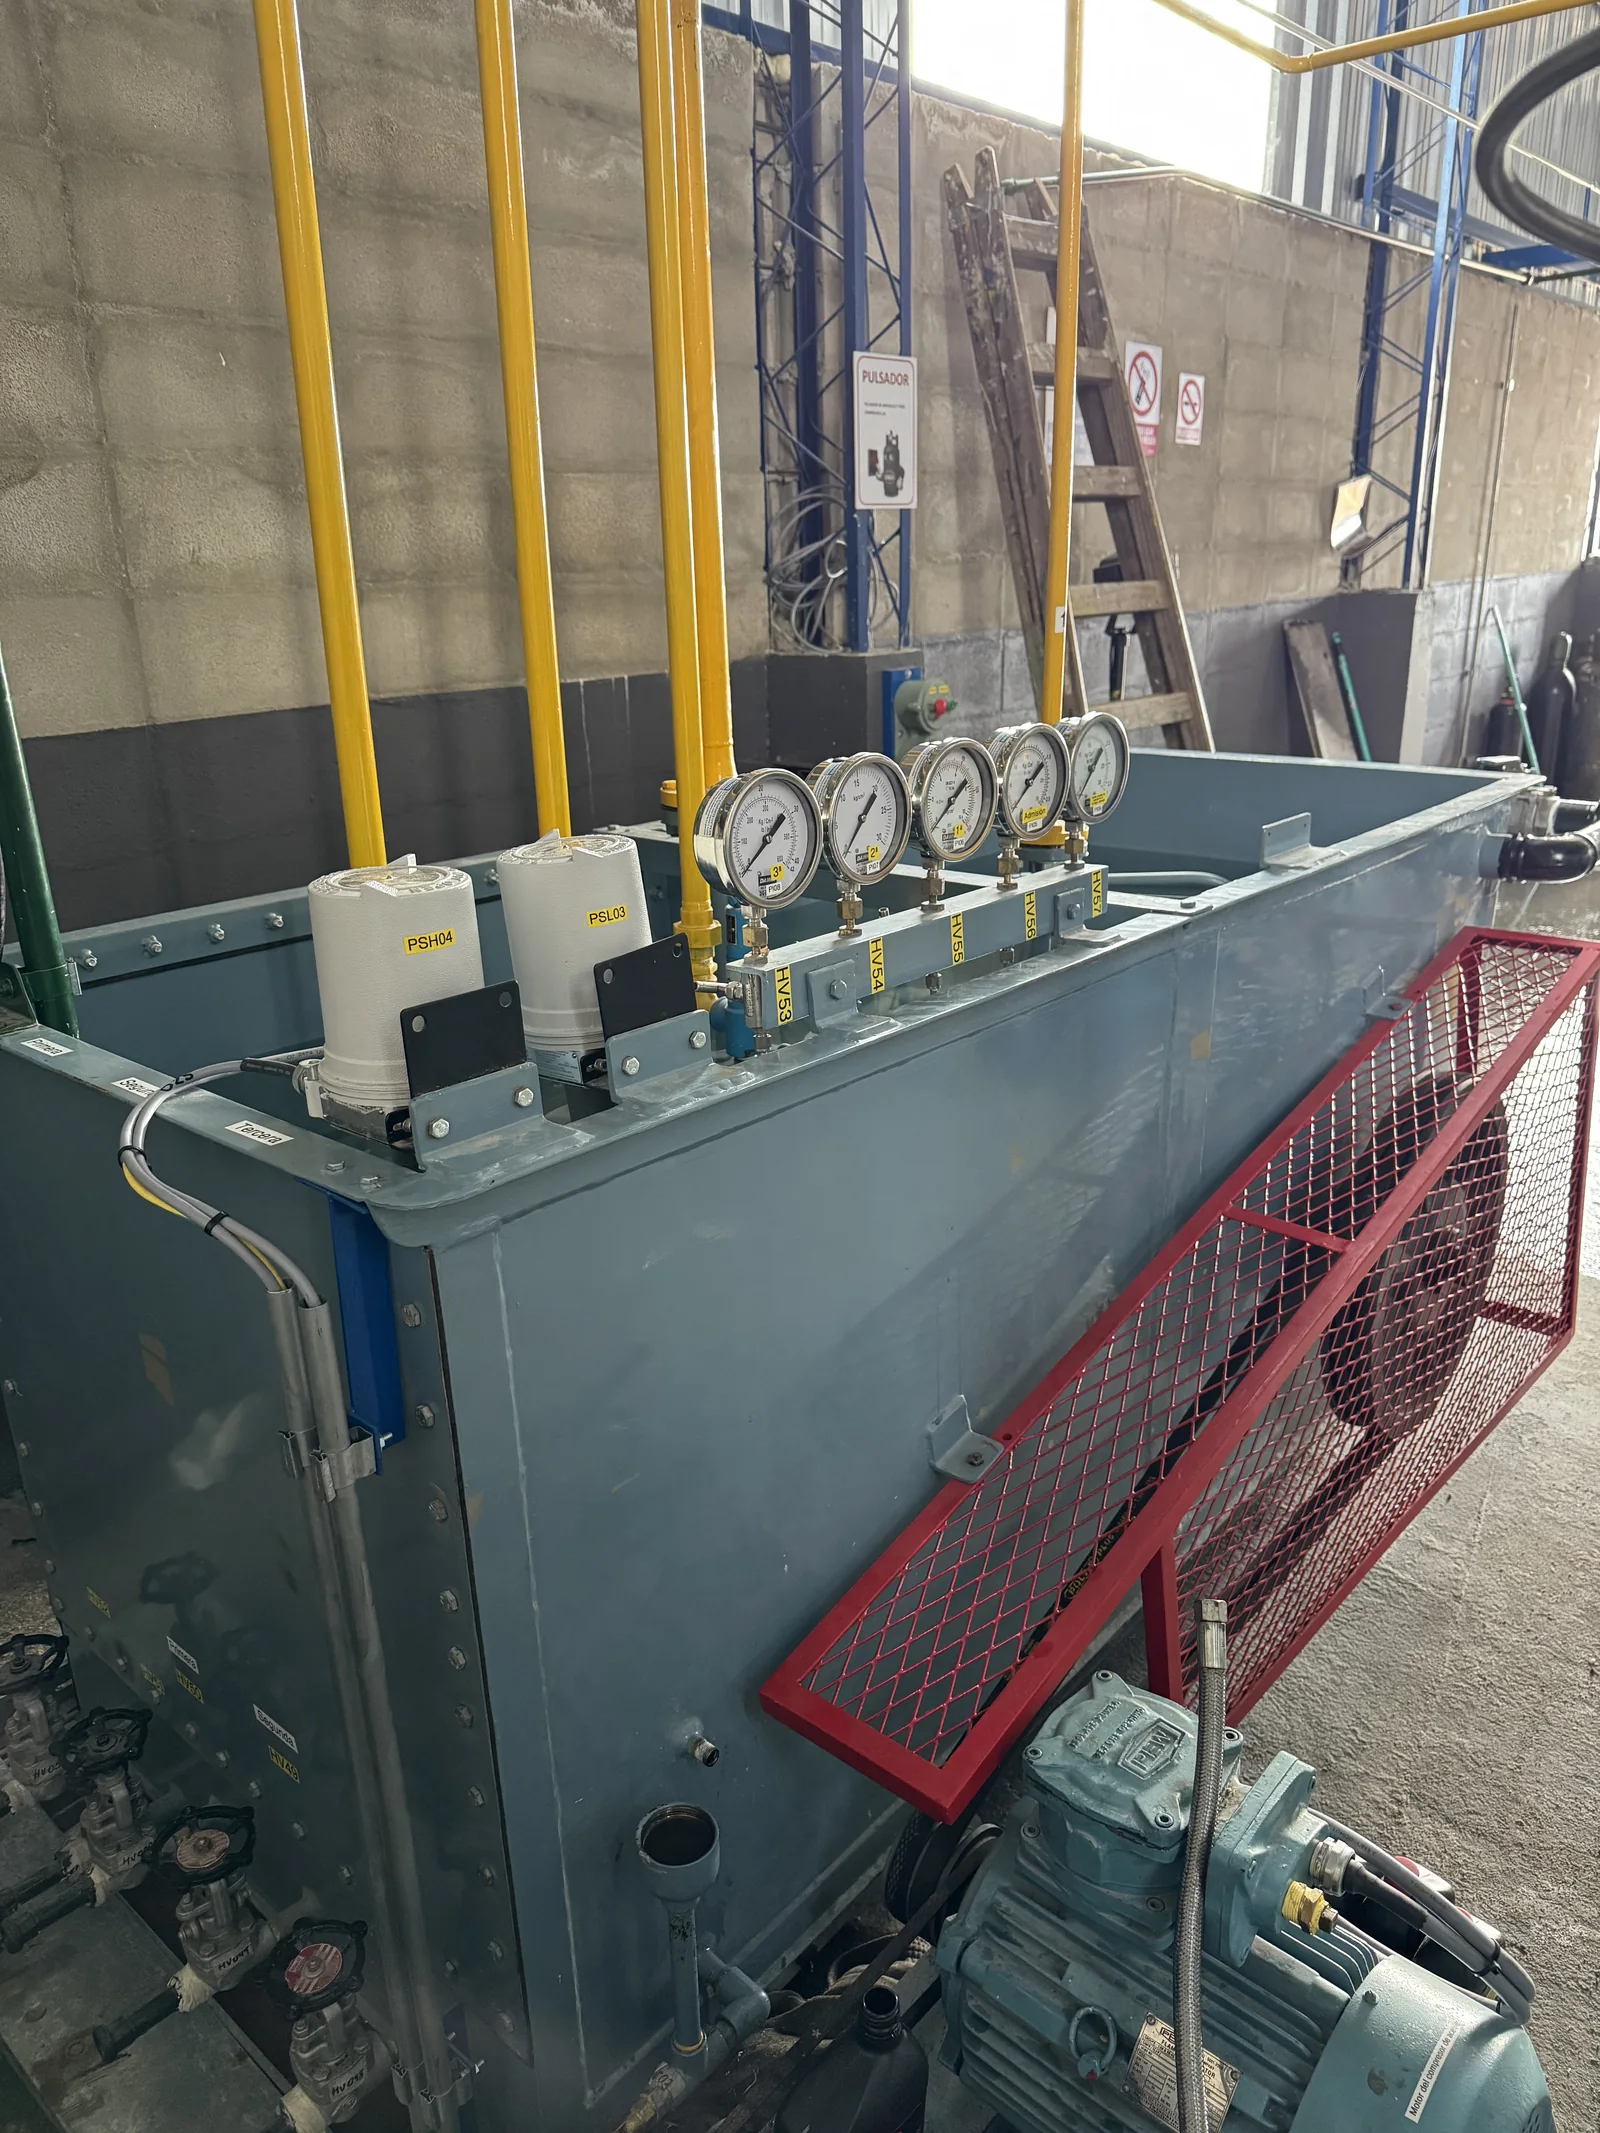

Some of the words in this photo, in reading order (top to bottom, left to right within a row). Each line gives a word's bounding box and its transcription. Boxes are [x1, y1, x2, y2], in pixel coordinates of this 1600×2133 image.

[862, 369, 909, 386] PULSADOR
[881, 806, 887, 814] 25
[868, 862, 879, 872] PI07
[768, 884, 781, 893] PI08
[1092, 870, 1103, 913] HV57
[589, 906, 627, 925] PSL03
[1025, 891, 1036, 939] HV56
[407, 932, 453, 952] PSH04
[951, 914, 964, 963] HV55
[871, 938, 884, 990] HV54
[777, 966, 792, 1022] HV53
[29, 1037, 63, 1057] Primera
[233, 1122, 283, 1145] Tercera
[177, 1671, 202, 1700] HV50
[257, 1708, 294, 1747] Segunda
[271, 1750, 299, 1781] HV49
[1409, 2092, 1424, 2117] Motor
[1420, 2078, 1430, 2093] del
[1426, 2045, 1447, 2080] compresor
[1443, 2037, 1451, 2046] de
